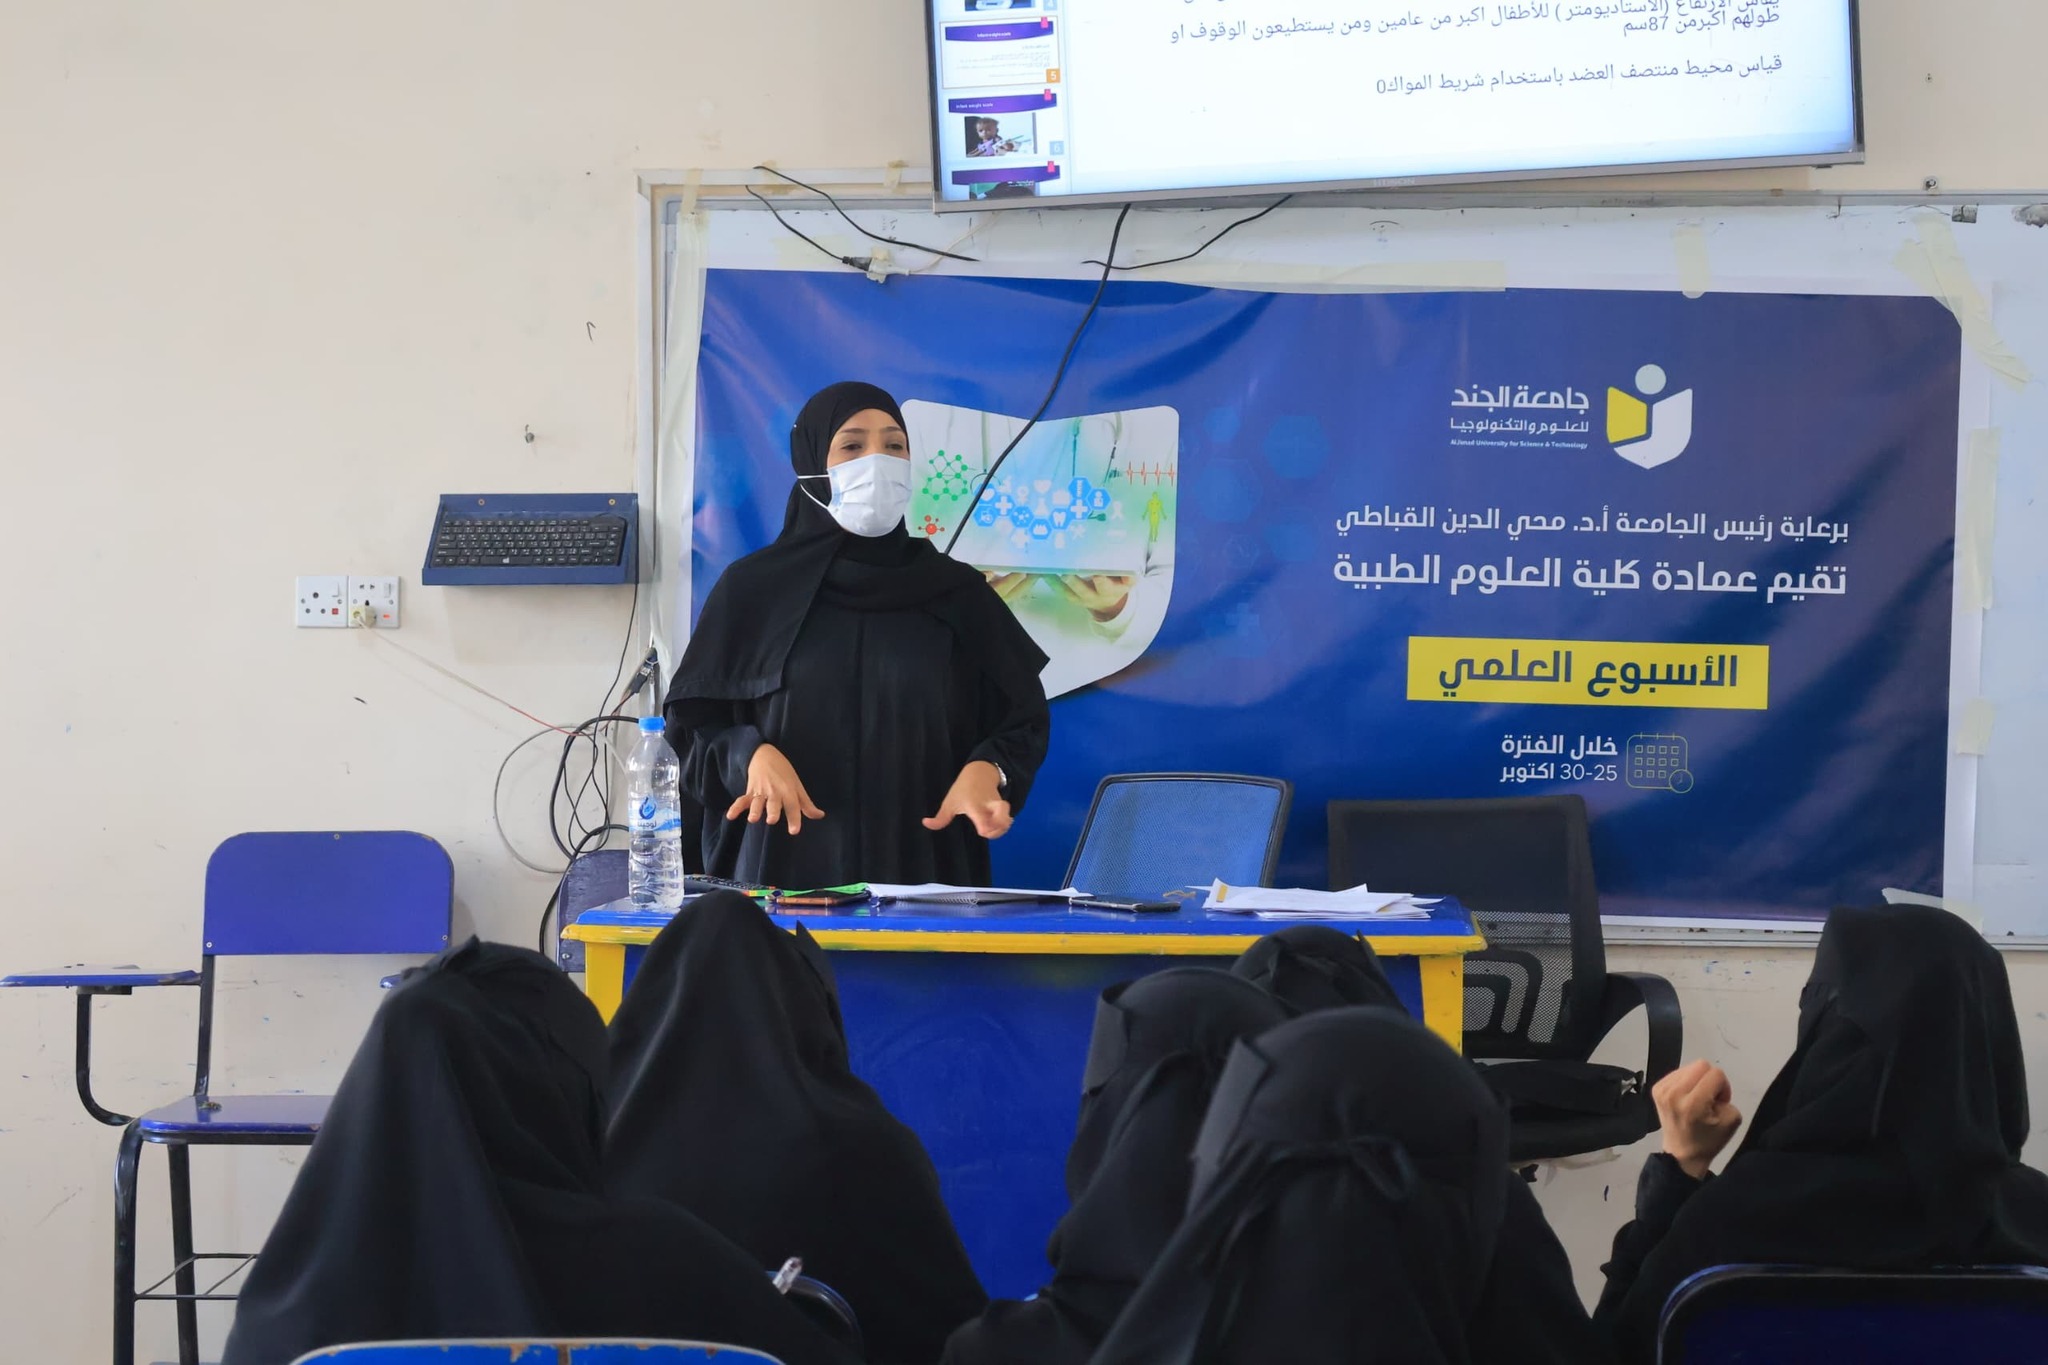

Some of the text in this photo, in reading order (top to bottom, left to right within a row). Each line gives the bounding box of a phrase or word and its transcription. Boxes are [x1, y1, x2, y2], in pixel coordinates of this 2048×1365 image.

[1378, 11, 1424, 33] عامين
[1430, 13, 1452, 30] من
[1490, 1, 1549, 26] للأطفال
[1732, 8, 1780, 31] طولهم
[1171, 24, 1184, 44] او
[1190, 20, 1246, 42] الوقوف
[1252, 17, 1334, 41] يستطيعون
[1340, 19, 1371, 36] ومن
[1569, 64, 1614, 81] العضد
[1620, 63, 1679, 79] منتصف
[1685, 59, 1733, 78] محيط
[1739, 54, 1783, 78] قياس
[1438, 72, 1484, 92] شريط
[1490, 66, 1563, 92] باستخدام
[1451, 384, 1589, 415] جامعة الجند
[1450, 417, 1536, 435] والتكنولوجيا
[1336, 504, 1435, 537] القباطي
[1442, 507, 1500, 534] الدين
[1507, 515, 1566, 541] محي
[1616, 512, 1706, 539] الجامعة
[1713, 514, 1773, 542] رئيس
[1780, 515, 1849, 544] برعاية
[1333, 553, 1847, 604] تقيم عمادة كلية العلوم الطبية
[1439, 649, 1738, 698] الأسبوع العلمي
[1501, 734, 1618, 761] خلال الفترة
[1499, 762, 1555, 784] اكتوبر
